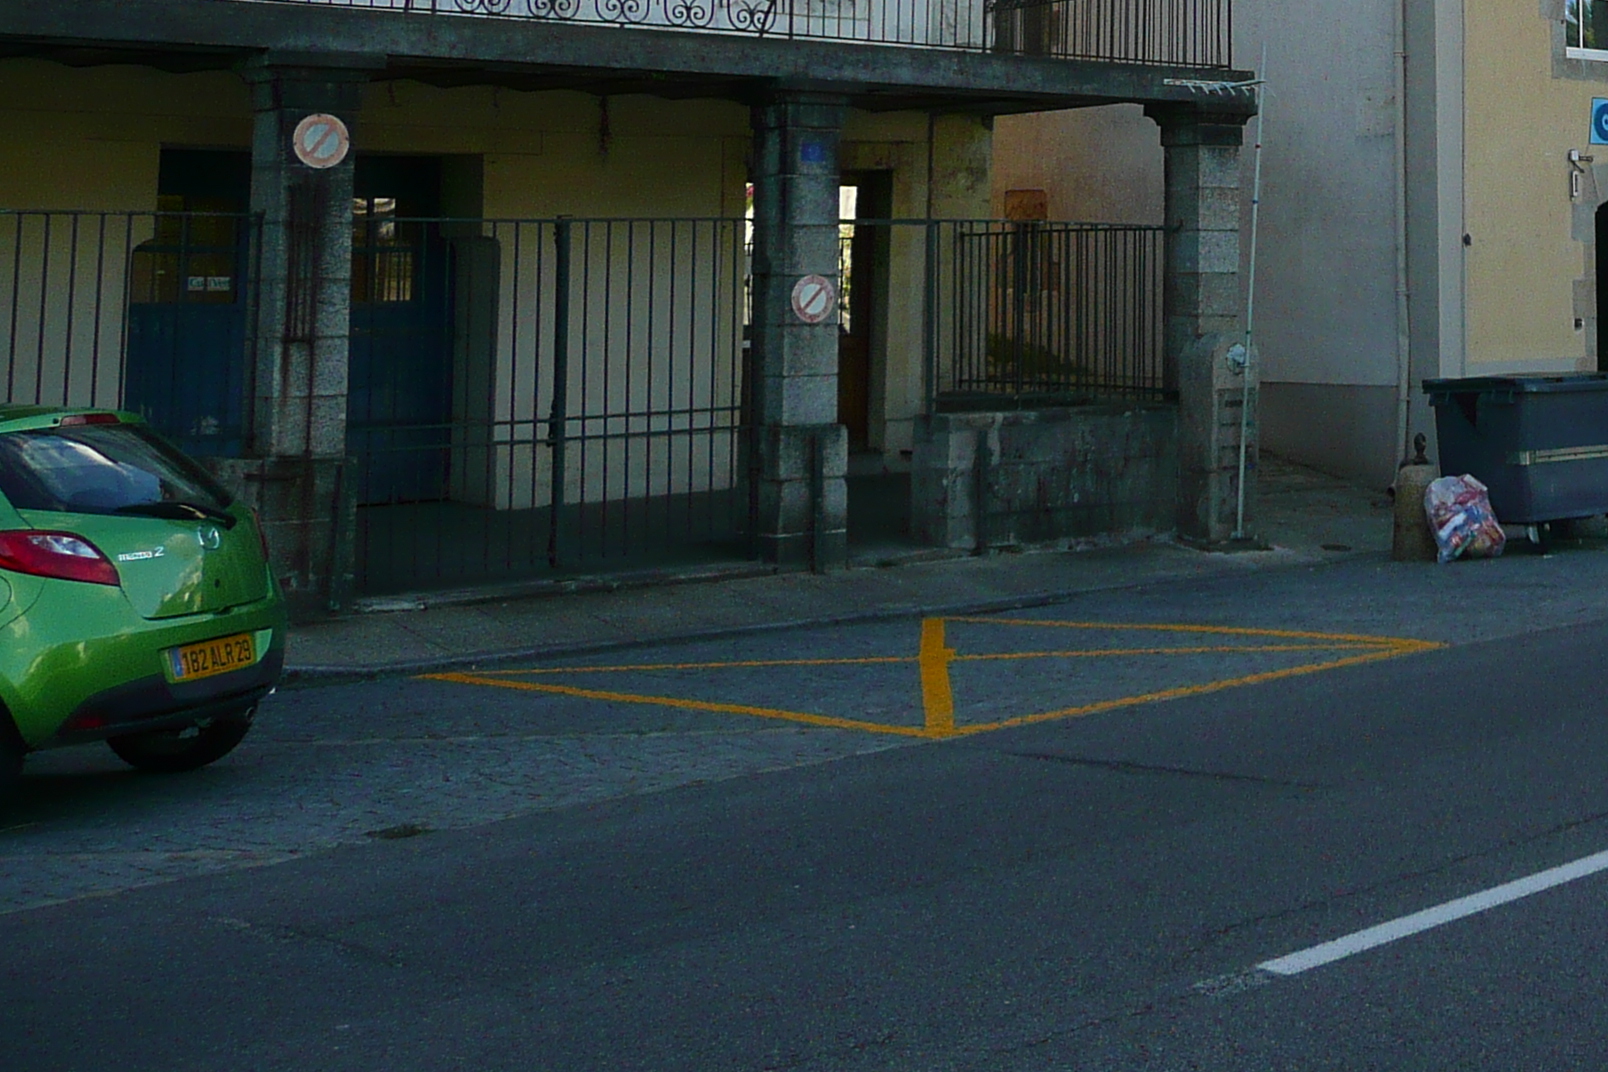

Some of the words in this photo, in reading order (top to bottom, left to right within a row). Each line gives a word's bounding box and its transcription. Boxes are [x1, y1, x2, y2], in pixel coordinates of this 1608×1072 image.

[154, 546, 165, 558] 2
[183, 648, 209, 675] 182
[211, 640, 234, 668] ALR
[236, 639, 252, 664] 29
